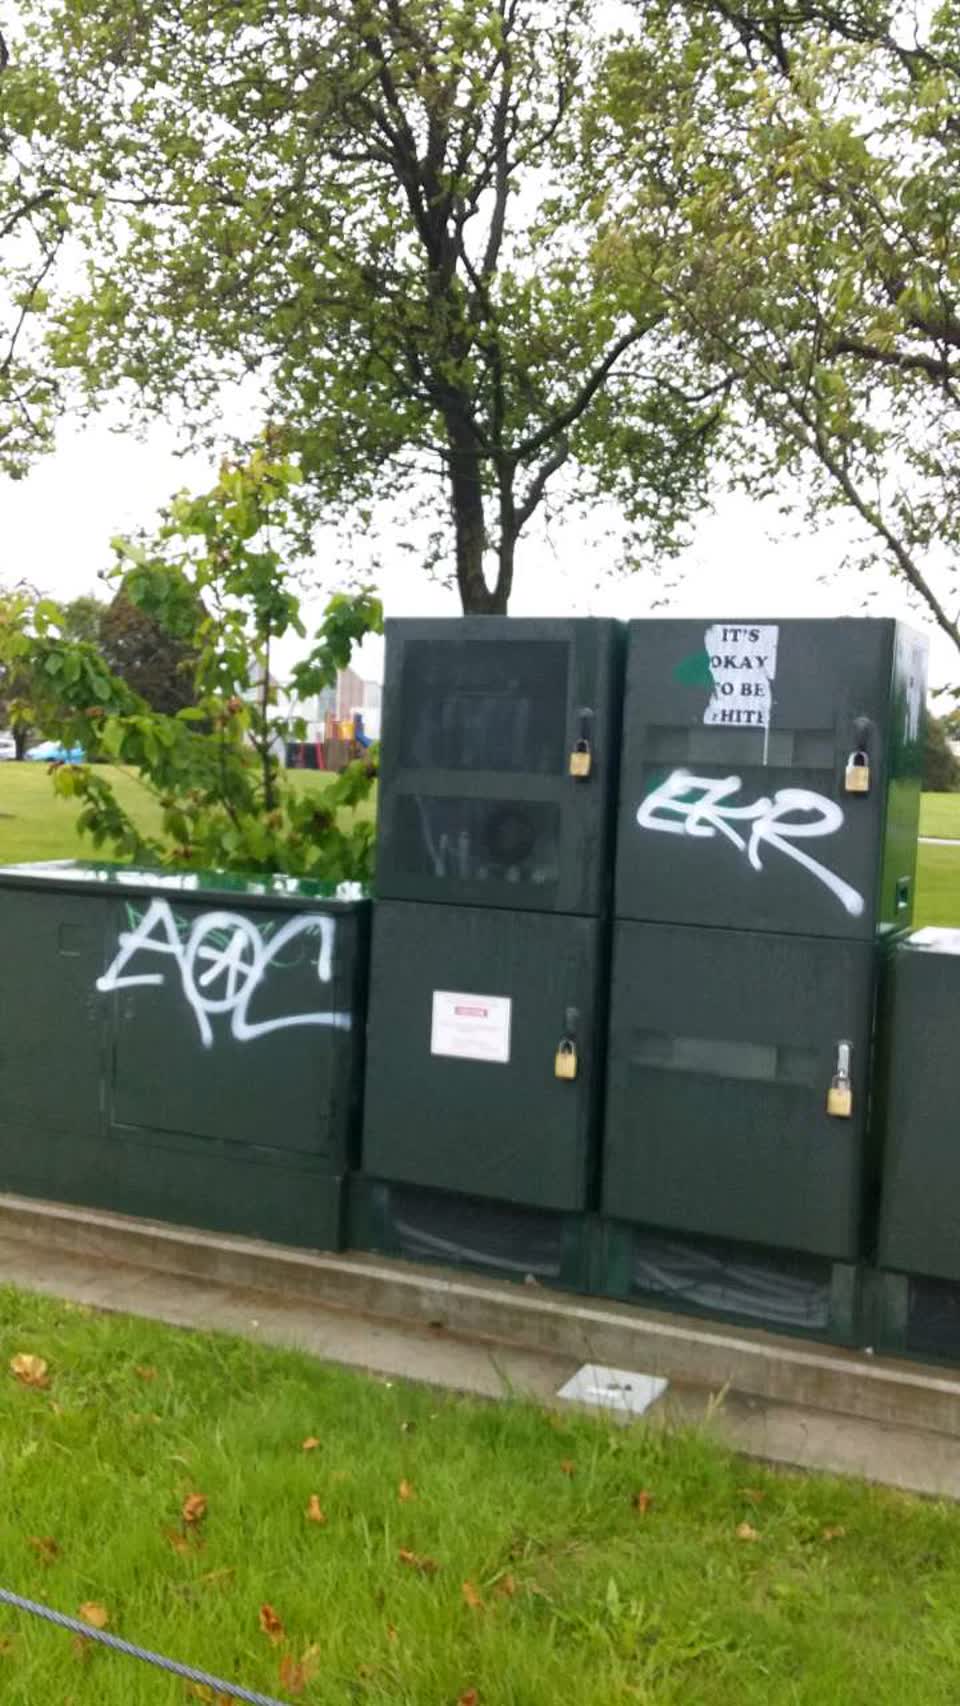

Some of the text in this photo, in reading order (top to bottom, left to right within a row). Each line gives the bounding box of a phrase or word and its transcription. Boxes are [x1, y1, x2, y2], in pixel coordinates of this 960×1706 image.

[722, 628, 760, 643] IT'S
[711, 655, 768, 669] OKAY
[715, 682, 765, 697] O BE
